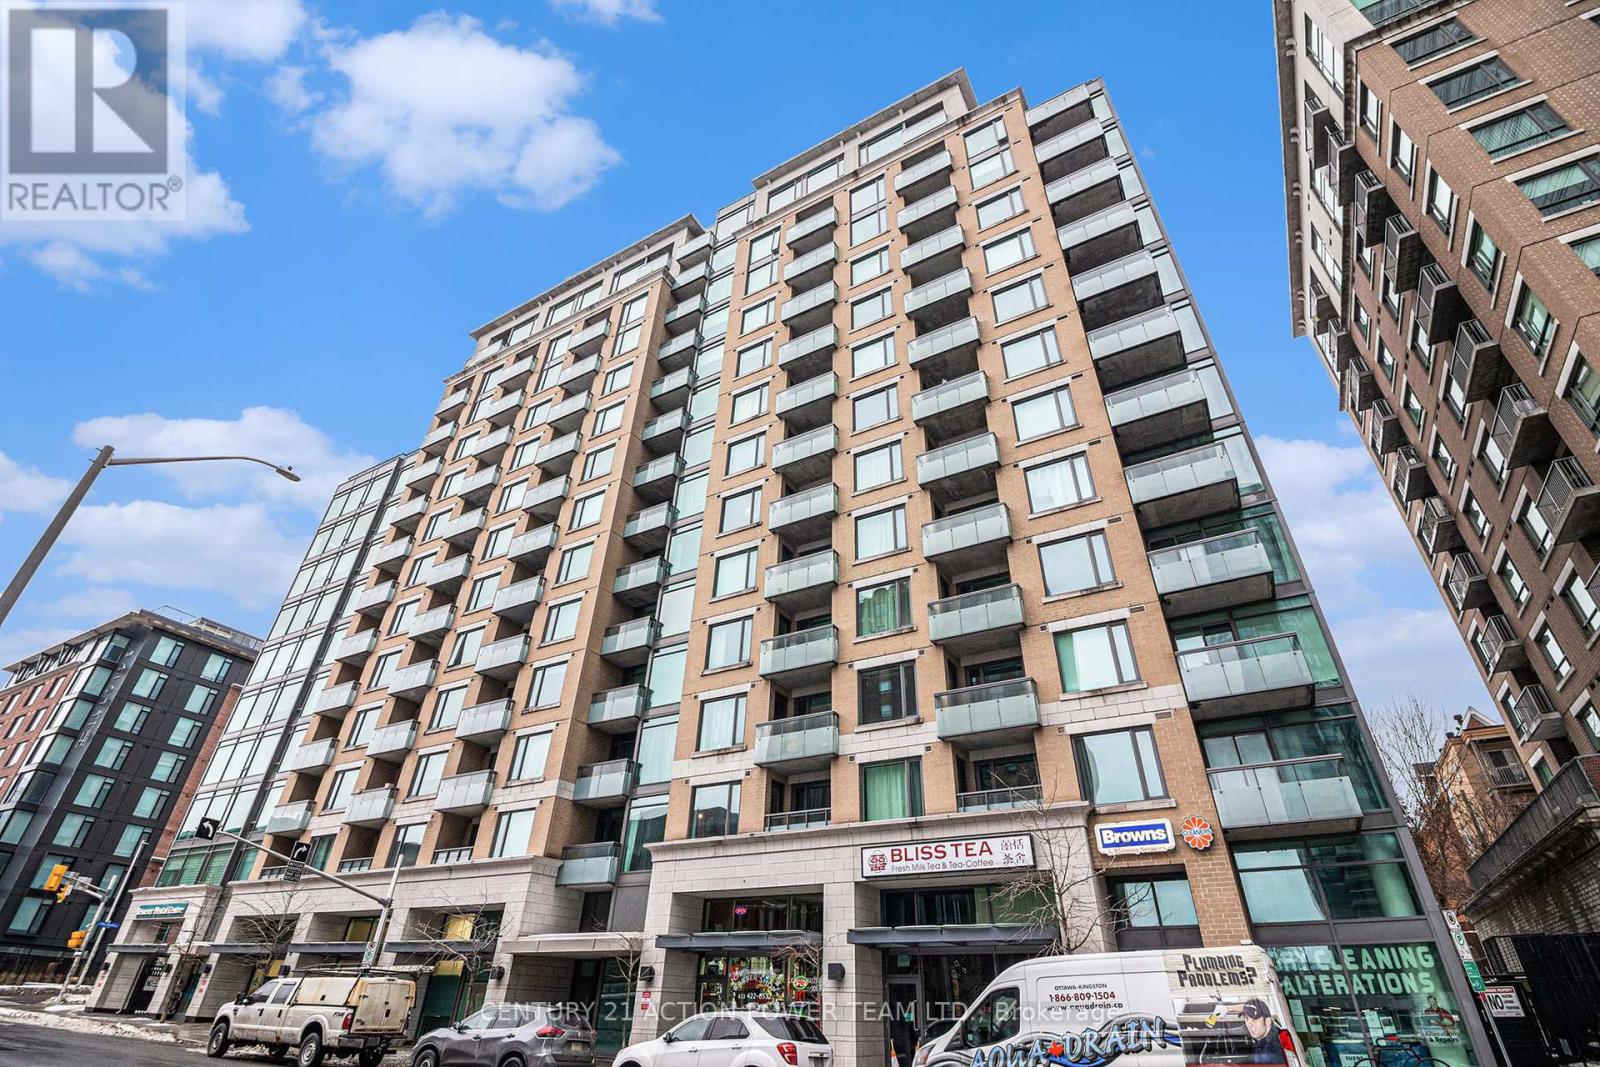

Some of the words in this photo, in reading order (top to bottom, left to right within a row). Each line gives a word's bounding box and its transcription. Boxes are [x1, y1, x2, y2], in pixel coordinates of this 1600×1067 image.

[1101, 828, 1167, 844] Browns
[891, 844, 947, 863] BLISS
[950, 840, 993, 858] TEA
[891, 865, 911, 873] Fresh
[912, 863, 926, 872] Milk
[927, 862, 940, 870] Tea
[941, 861, 947, 869] &
[1314, 945, 1435, 971] CLEANING
[1054, 983, 1108, 991] OTTAWA-KINGSTON
[1281, 972, 1435, 997] ALTERATIONS
[1487, 995, 1505, 1010] NO
[1062, 1015, 1167, 1062] DRAIN
